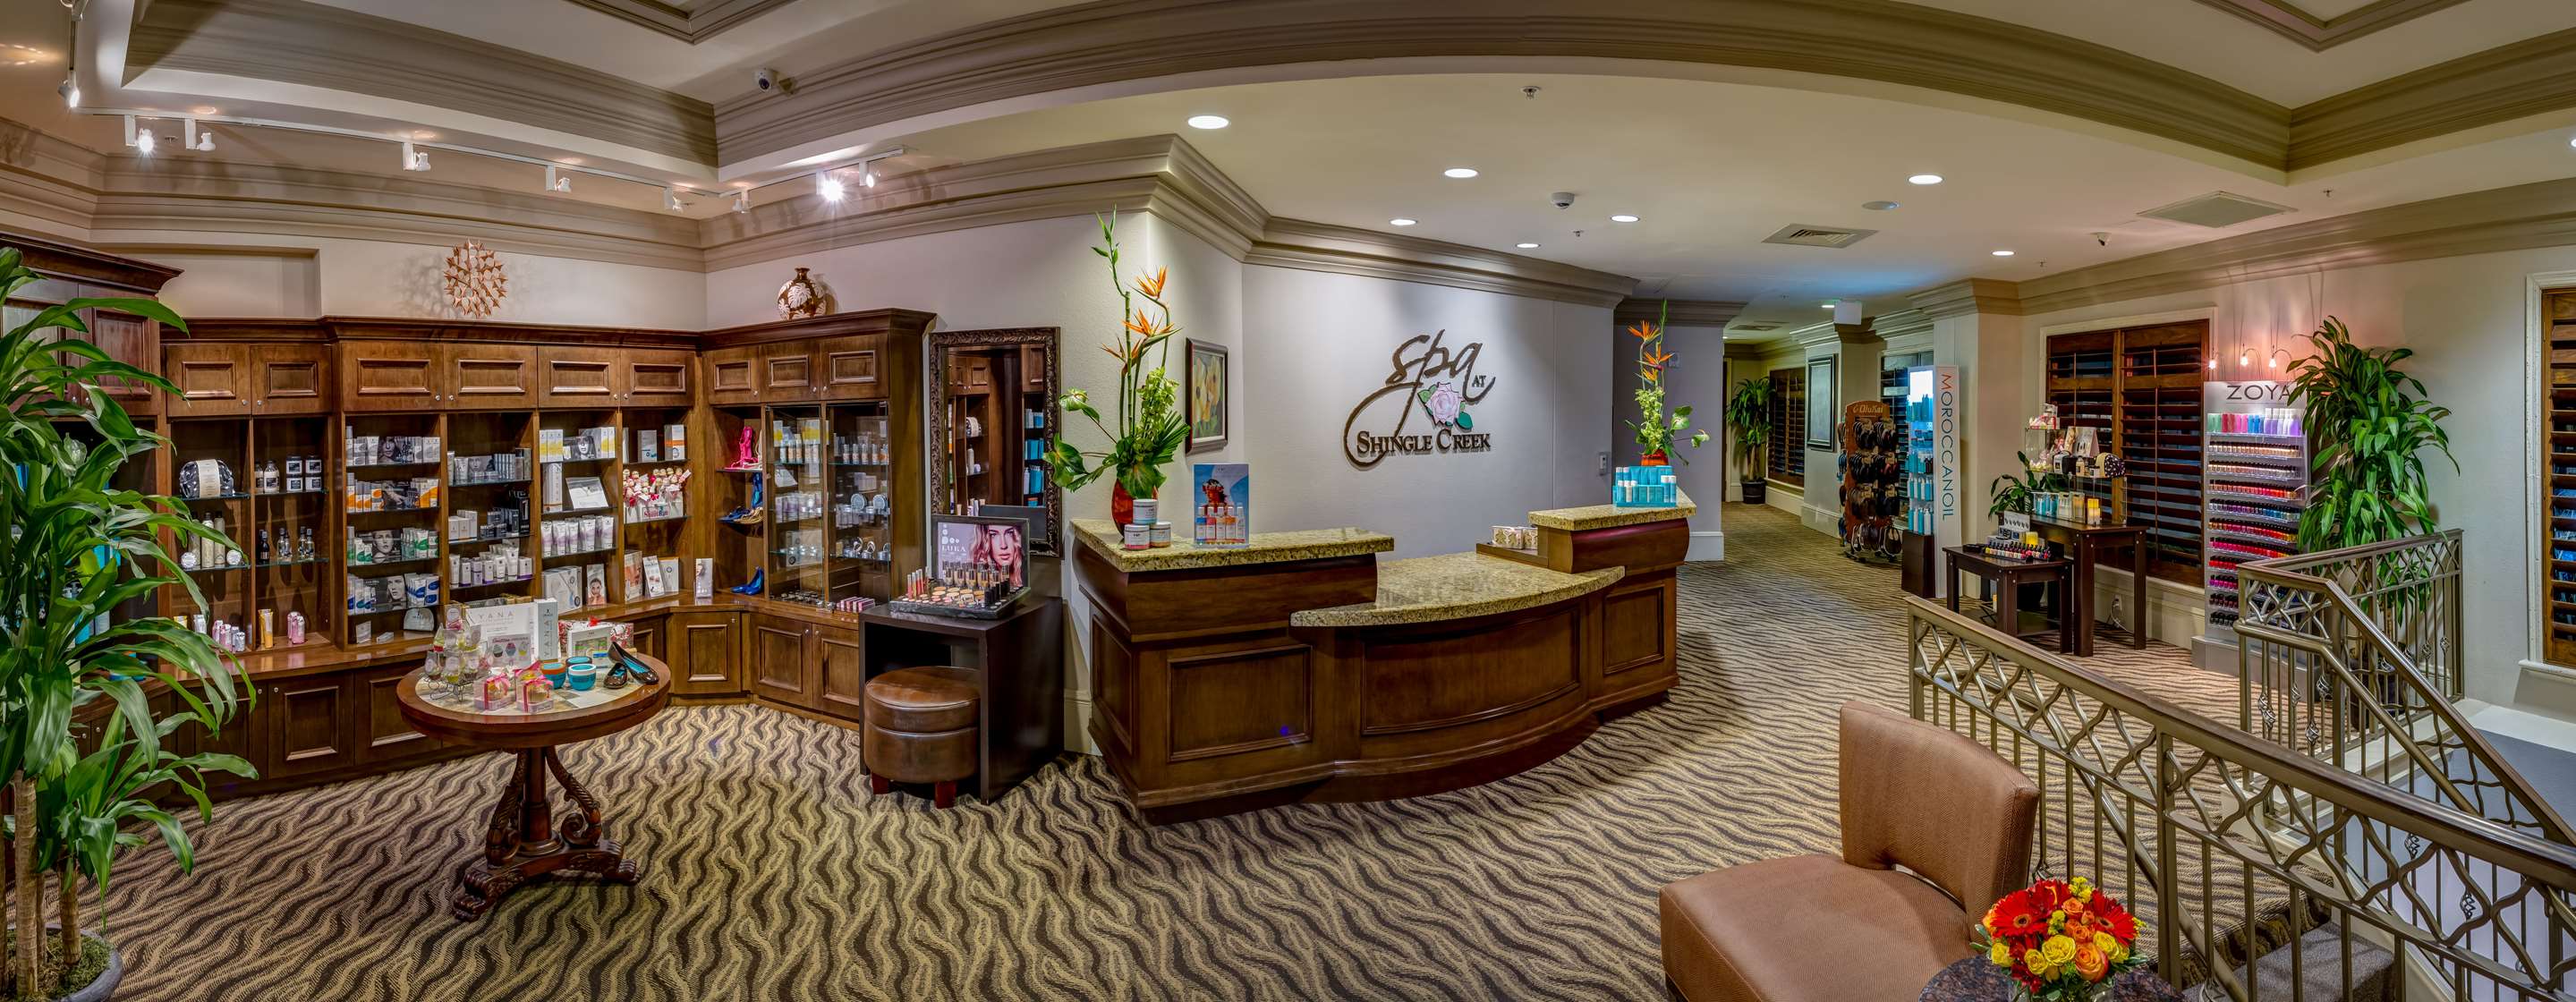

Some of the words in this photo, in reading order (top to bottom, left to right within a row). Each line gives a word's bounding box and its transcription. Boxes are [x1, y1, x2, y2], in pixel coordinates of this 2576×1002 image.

[1471, 375, 1486, 387] AT
[2226, 385, 2291, 400] ZOYA
[1356, 430, 1433, 454] SHINGLE
[1436, 429, 1492, 451] CREEK
[1941, 374, 1954, 522] MOROCCANOIL
